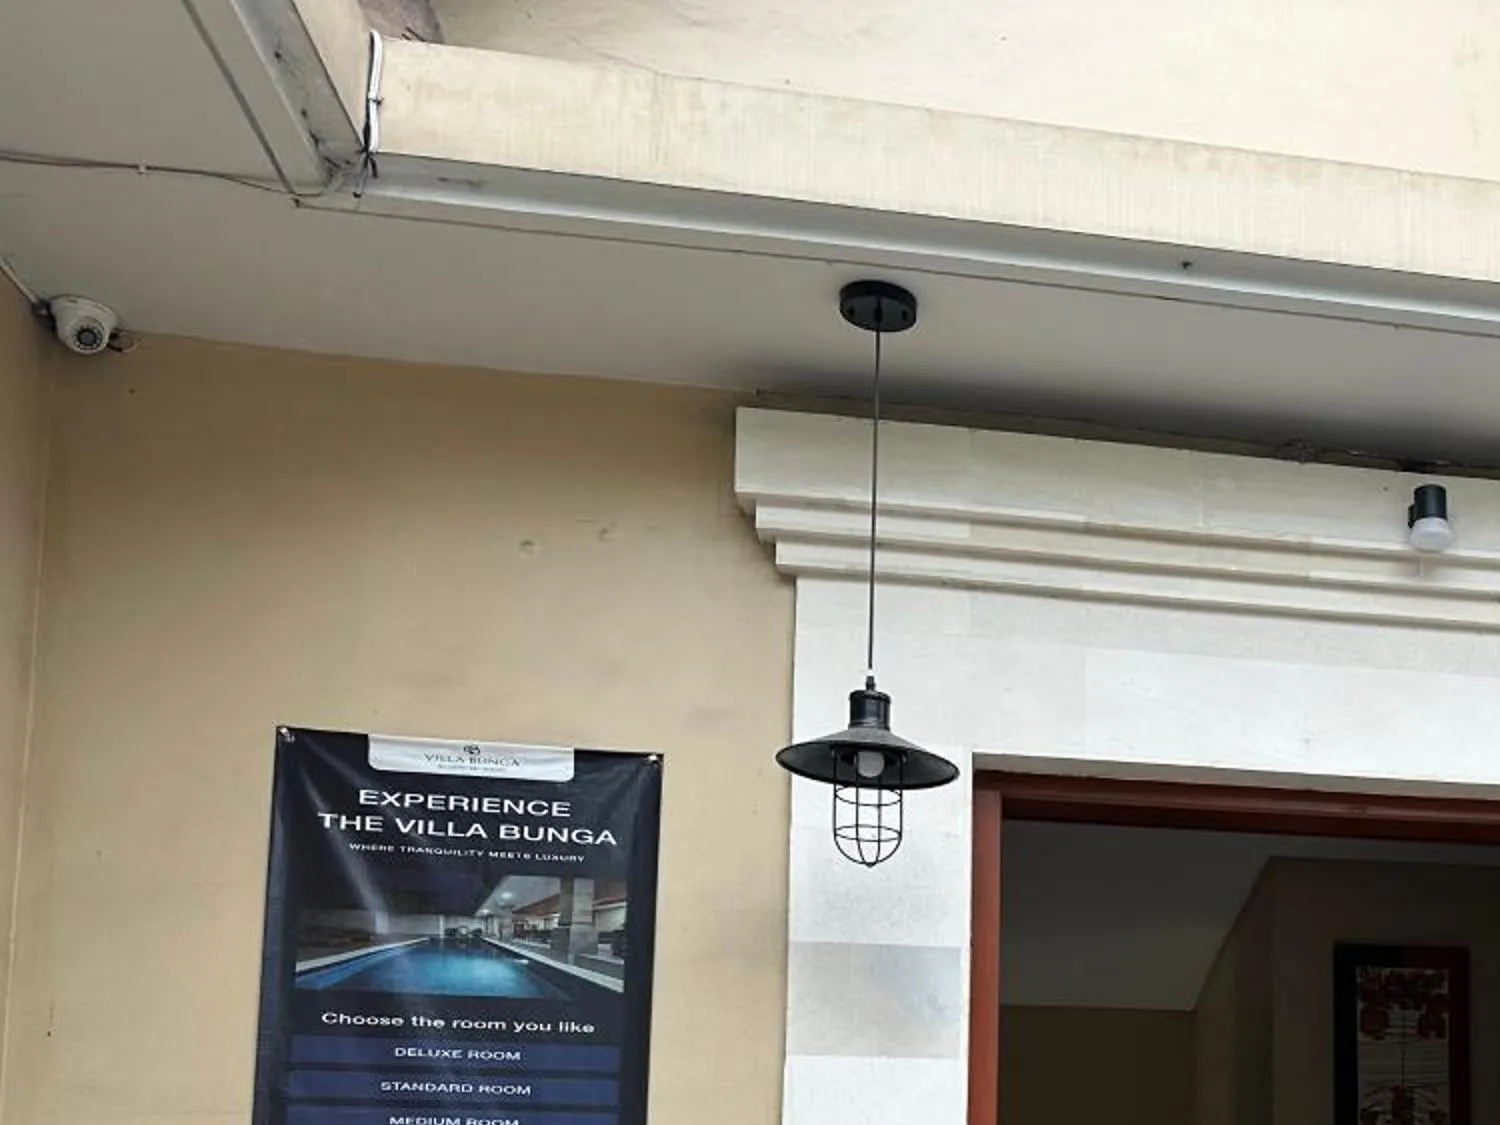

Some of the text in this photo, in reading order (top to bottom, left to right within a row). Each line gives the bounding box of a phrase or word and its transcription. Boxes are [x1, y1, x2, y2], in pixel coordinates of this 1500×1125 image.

[358, 789, 571, 817] EXPERIENCE
[317, 812, 617, 846] THE VILLA BUNGA
[349, 843, 585, 862] WHERE TRANQUILITY MEETS LUXURY
[321, 1012, 595, 1034] Choose the room you like
[394, 1047, 522, 1061] DELUXE ROOM
[380, 1081, 532, 1095] STANDARD ROOM
